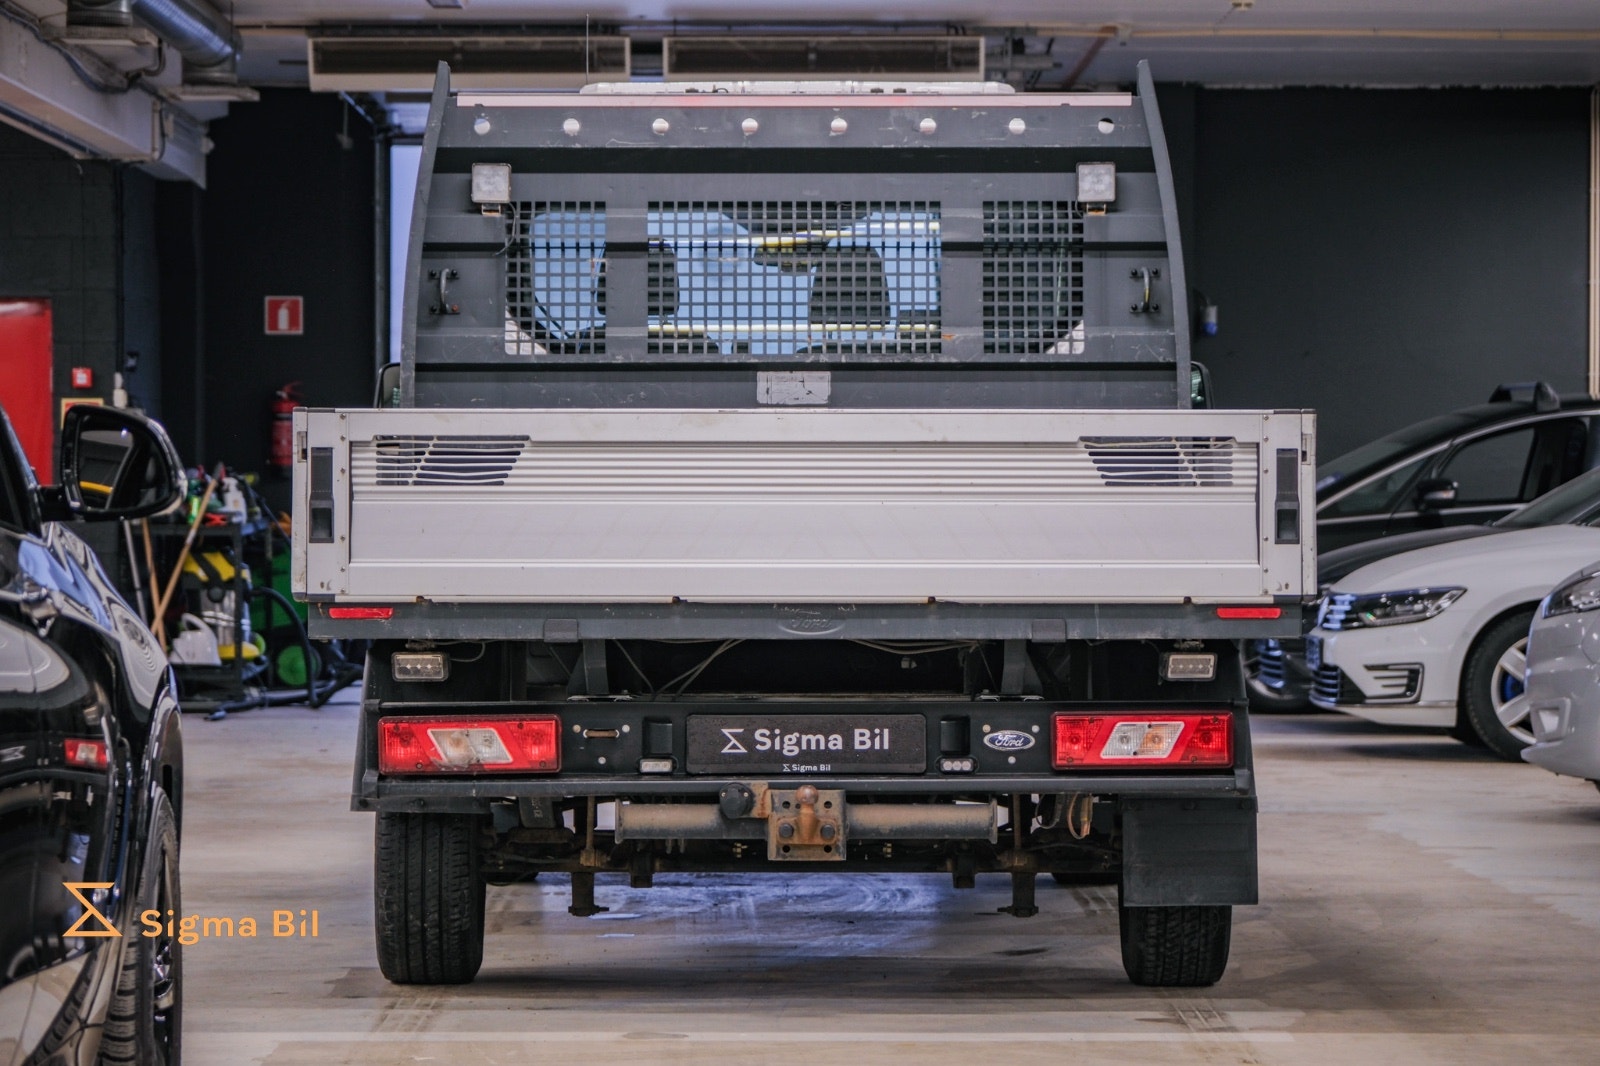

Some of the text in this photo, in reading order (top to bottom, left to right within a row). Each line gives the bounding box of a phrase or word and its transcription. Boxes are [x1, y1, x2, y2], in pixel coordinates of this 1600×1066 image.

[754, 728, 889, 757] Sigma Bil
[995, 732, 1025, 747] Ford
[791, 764, 831, 773] Sigma Bil
